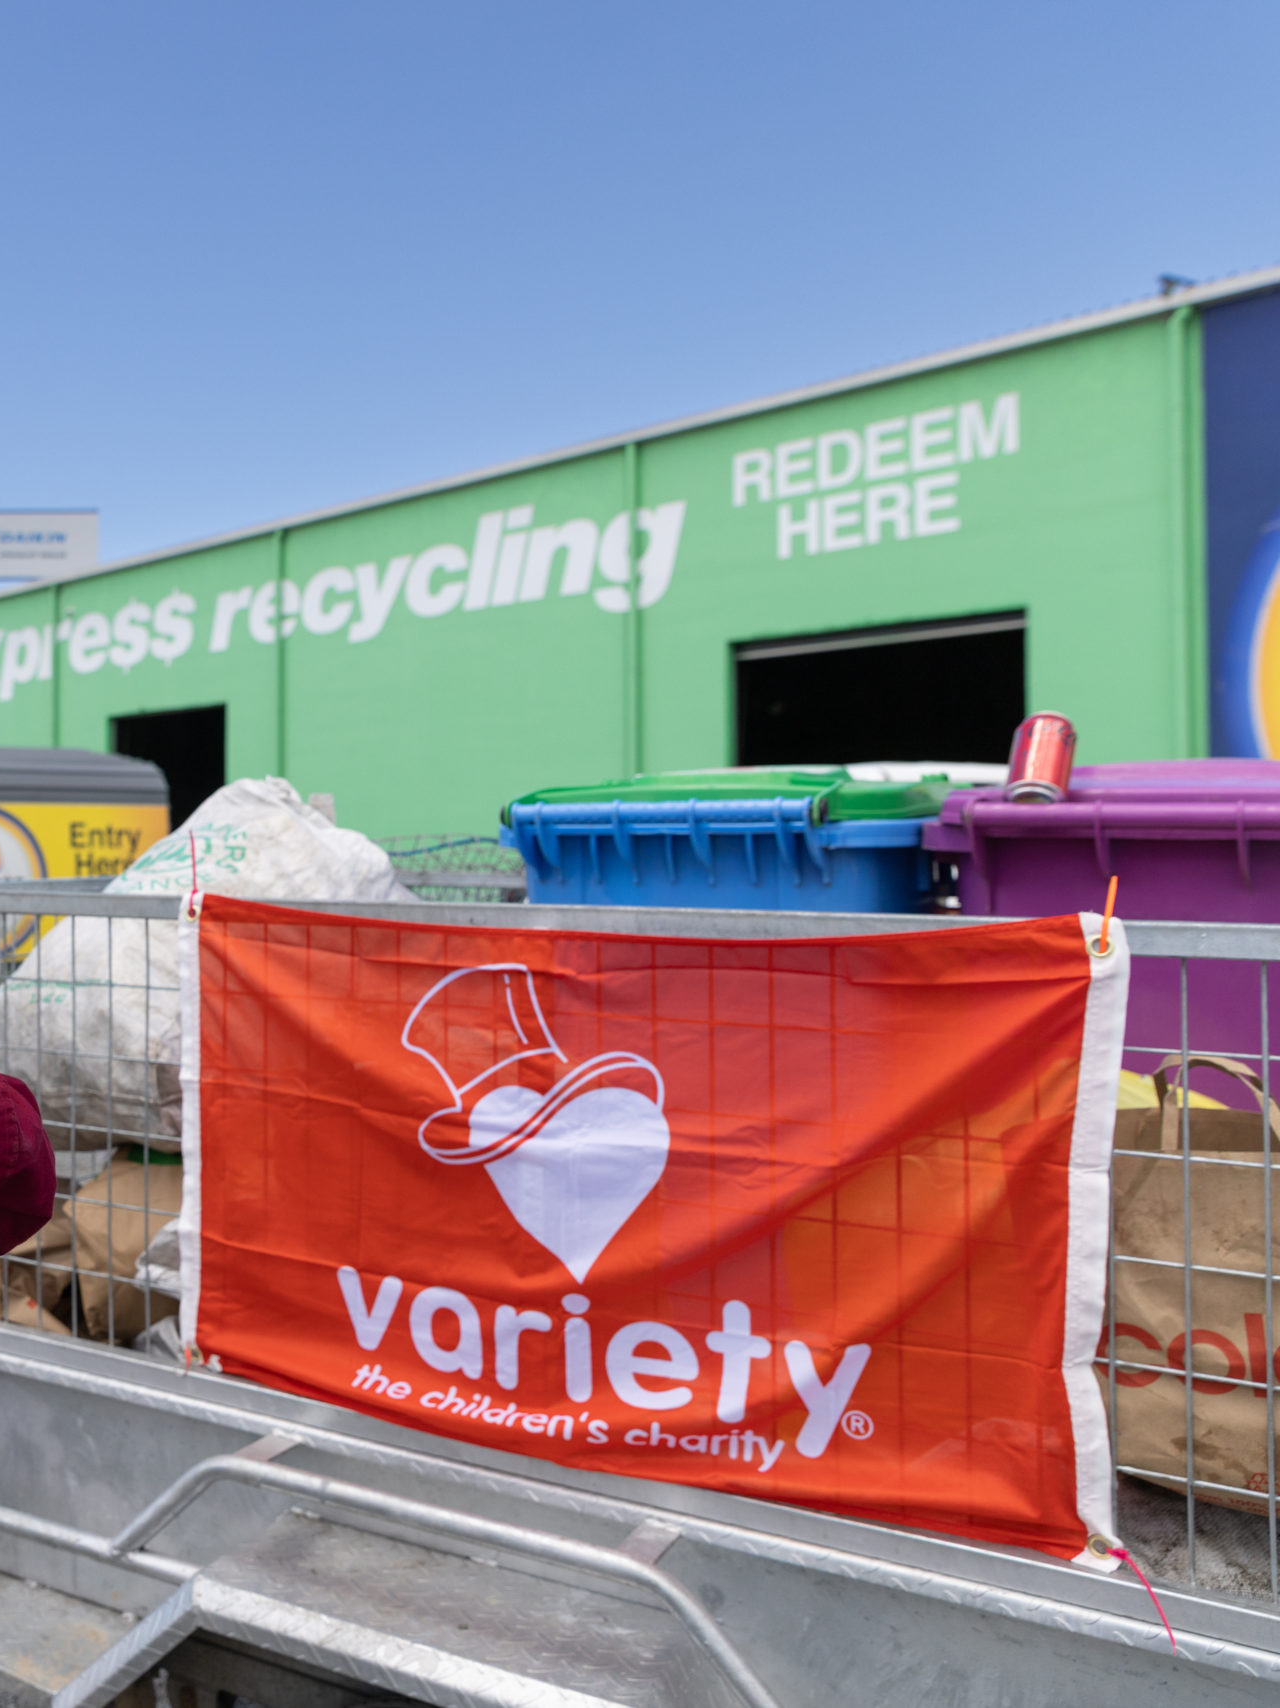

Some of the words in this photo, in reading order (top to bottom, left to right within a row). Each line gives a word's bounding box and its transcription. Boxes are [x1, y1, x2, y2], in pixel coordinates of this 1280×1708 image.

[732, 391, 1019, 507] REDEEM
[776, 471, 961, 560] HERE
[209, 500, 686, 652] recycling
[69, 822, 141, 858] Entry
[75, 853, 134, 877] Her
[336, 1265, 872, 1458] variety
[1098, 1311, 1280, 1399] col
[351, 1364, 412, 1400] the
[419, 1385, 609, 1445] children's
[623, 1422, 785, 1473] charity
